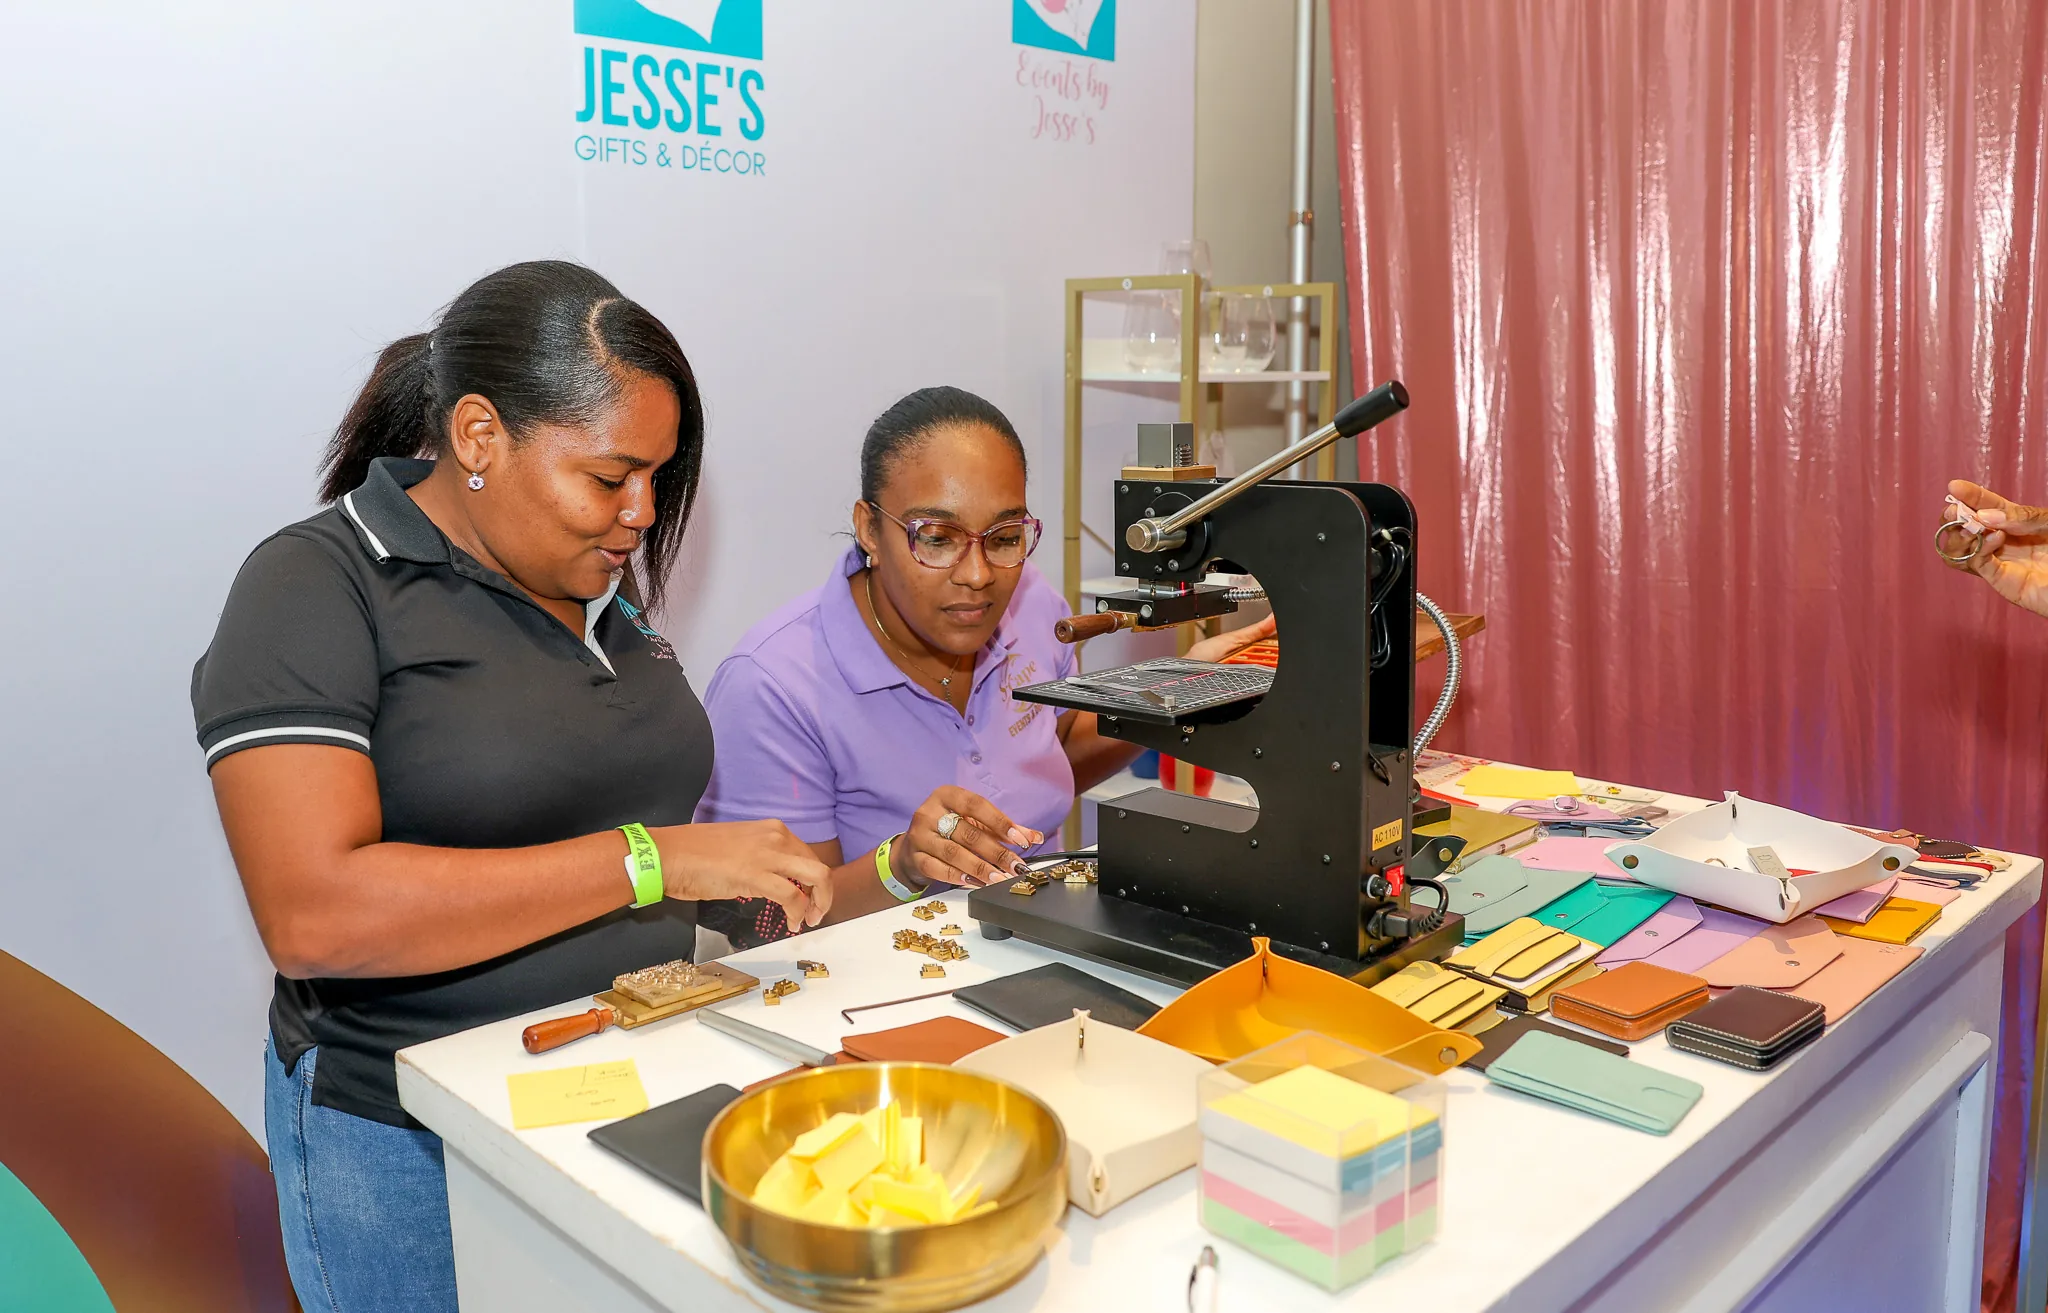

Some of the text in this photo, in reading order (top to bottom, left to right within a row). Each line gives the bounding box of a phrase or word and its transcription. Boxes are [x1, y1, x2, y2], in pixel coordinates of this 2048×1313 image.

[575, 46, 765, 141] JESSE'S
[1016, 49, 1108, 110] Events by
[1030, 94, 1096, 145] Jesse's
[574, 135, 766, 176] GIFTS & DÉCOR
[1374, 832, 1384, 845] AC
